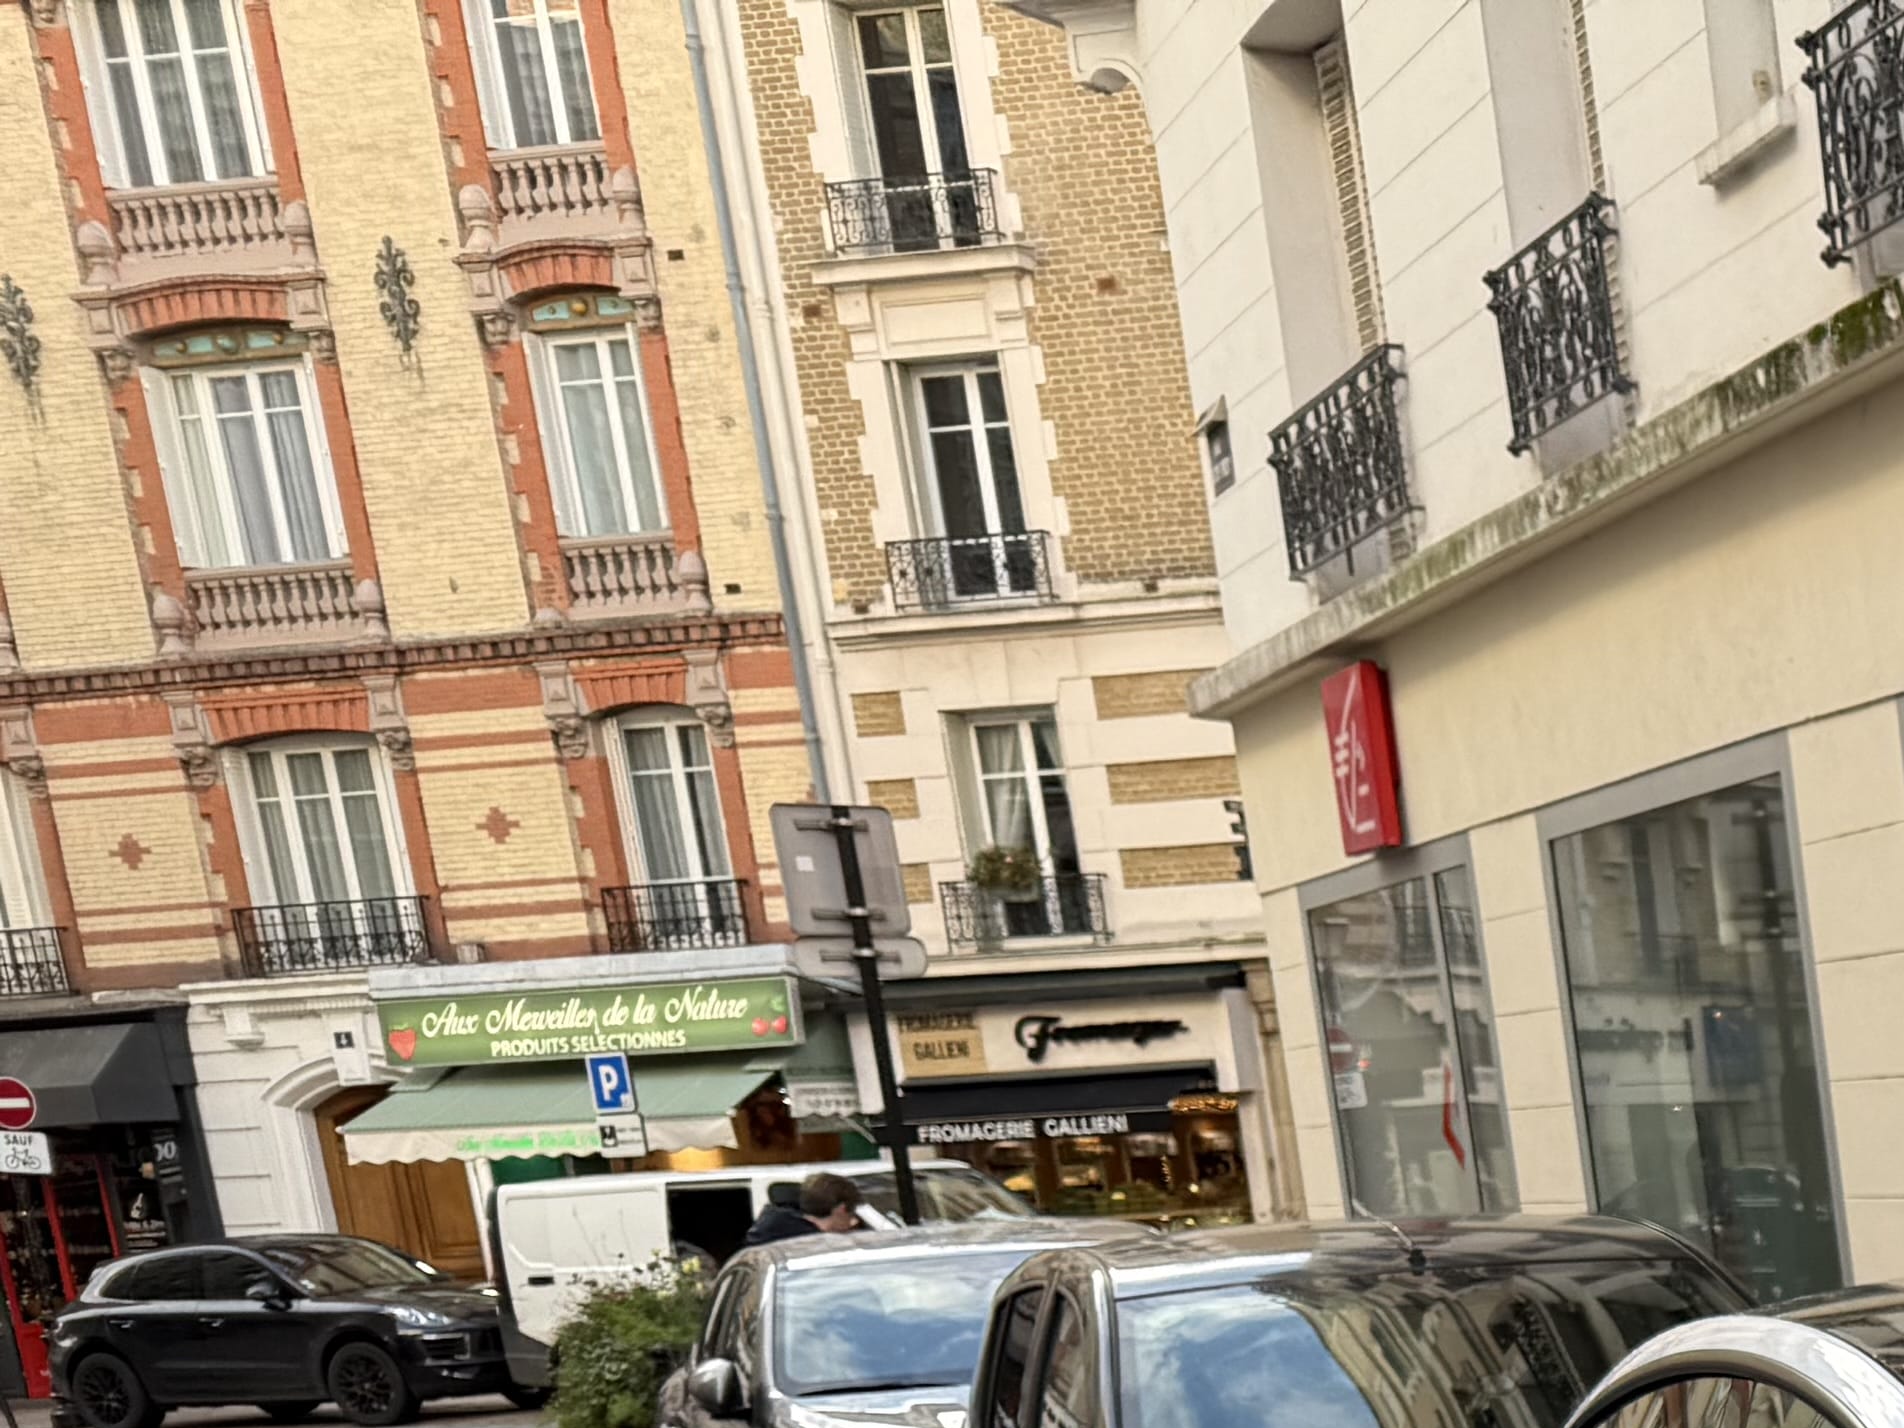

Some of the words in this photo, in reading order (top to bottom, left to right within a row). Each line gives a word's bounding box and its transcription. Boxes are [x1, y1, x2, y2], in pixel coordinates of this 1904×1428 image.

[421, 1002, 478, 1037] Aux
[485, 997, 600, 1034] Merveilles
[602, 994, 628, 1026] de
[632, 994, 657, 1024] la
[664, 985, 748, 1023] Nature
[489, 1036, 571, 1057] PRODUITS
[572, 1029, 686, 1053] SELECTIONNES
[599, 1064, 619, 1101] P
[4, 1134, 33, 1146] SAUF
[917, 1119, 1036, 1143] FROMAGERIE
[1043, 1114, 1129, 1138] GALLIENI
